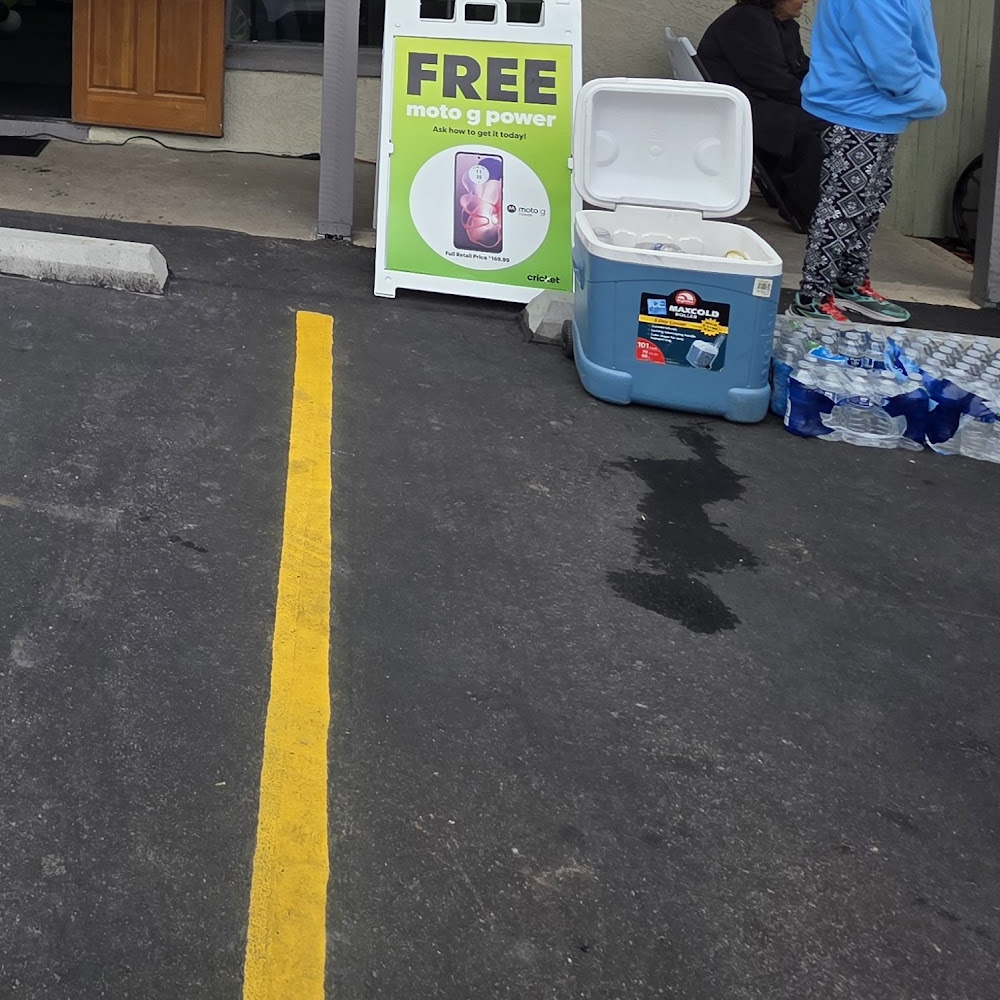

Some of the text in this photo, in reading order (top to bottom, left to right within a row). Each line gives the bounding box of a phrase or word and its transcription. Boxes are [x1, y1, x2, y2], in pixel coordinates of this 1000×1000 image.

[407, 52, 557, 106] FREE
[406, 104, 557, 127] moto g power
[433, 126, 447, 134] Ask
[448, 127, 466, 135] how
[477, 130, 492, 138] get
[500, 131, 527, 140] today!
[518, 206, 546, 216] moto g
[527, 273, 560, 284] cricket
[669, 305, 720, 318] MAXCOLD
